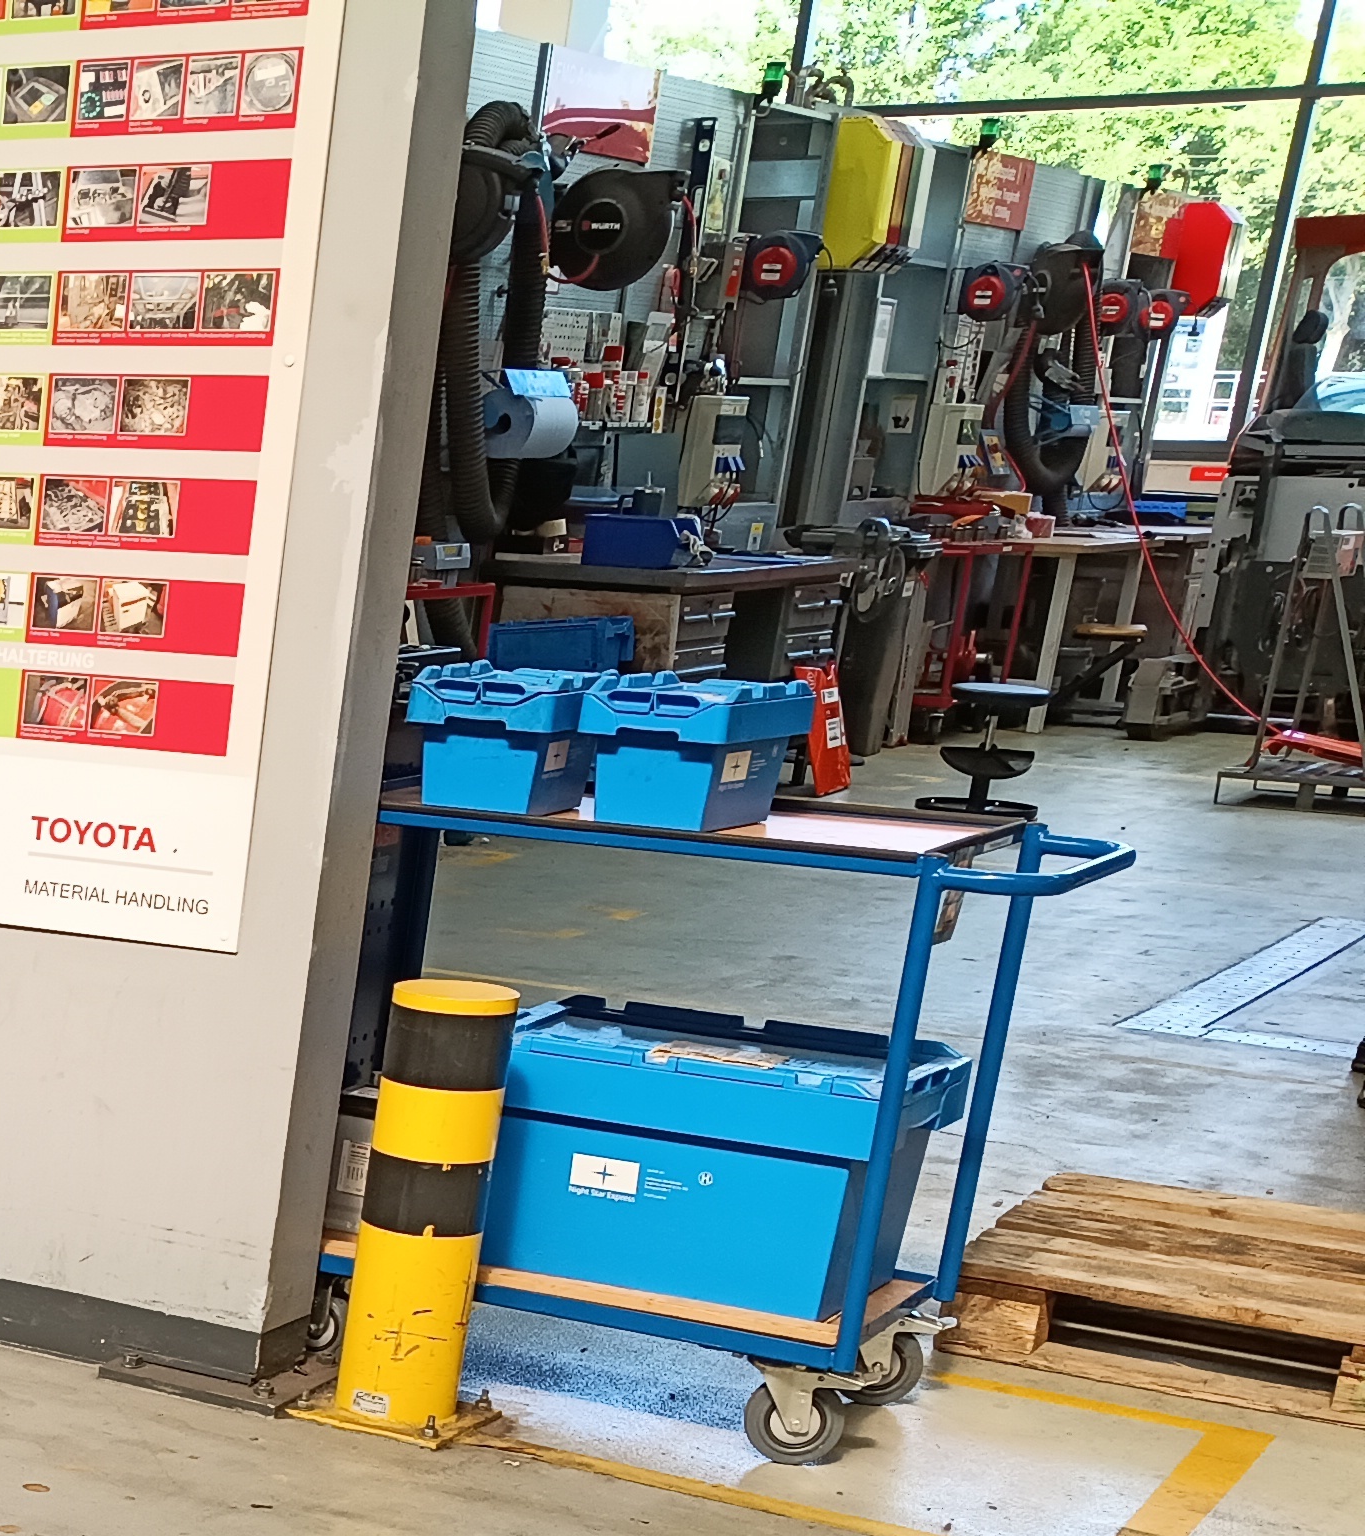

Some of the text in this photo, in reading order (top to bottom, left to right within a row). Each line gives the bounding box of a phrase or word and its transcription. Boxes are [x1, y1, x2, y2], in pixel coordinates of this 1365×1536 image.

[30, 815, 158, 853] TOYOTA
[23, 878, 211, 916] MATERIAL HANDLING
[568, 1184, 636, 1203] Night Star Express
